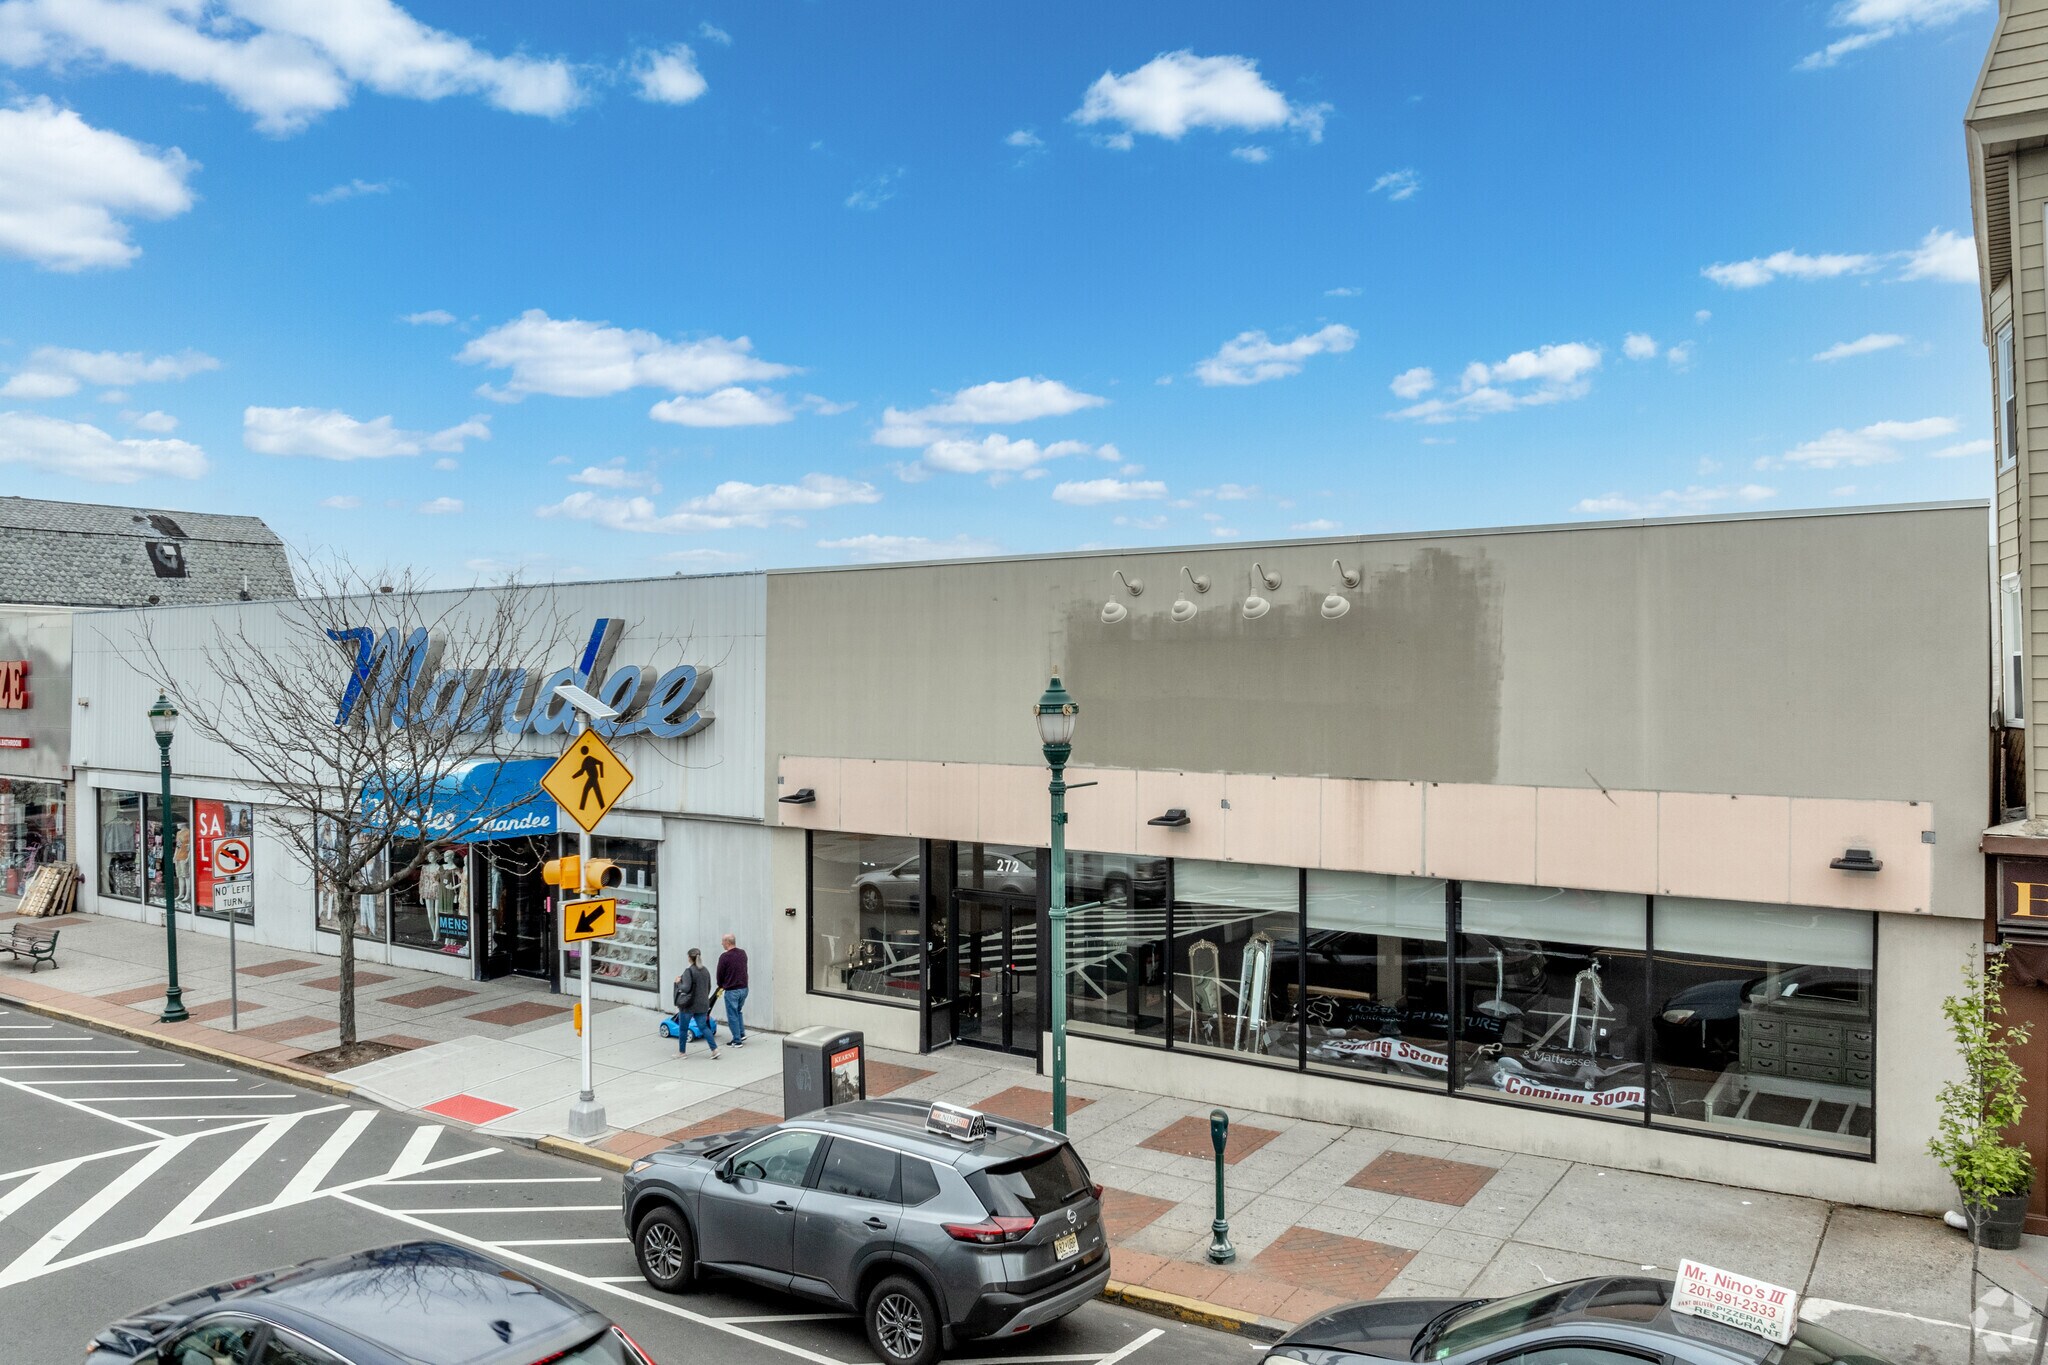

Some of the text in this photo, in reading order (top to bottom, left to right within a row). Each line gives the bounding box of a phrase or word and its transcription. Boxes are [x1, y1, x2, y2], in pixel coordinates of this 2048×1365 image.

[326, 617, 716, 738] Mandee
[470, 812, 551, 834] Mandee
[996, 859, 1019, 873] 272
[215, 884, 251, 896] NO LEFT
[223, 897, 243, 907] TURN
[439, 916, 468, 931] MENS
[1412, 1010, 1501, 1032] FURNTURE
[834, 1051, 856, 1064] KEARNY
[1534, 1051, 1598, 1068] Mattresses
[1505, 1077, 1584, 1104] Coming
[1684, 1264, 1788, 1306] Mr. Nino's III
[1688, 1282, 1776, 1319] 201-991-2333
[1694, 1306, 1781, 1338] RESTAURANT
[1716, 1305, 1764, 1325] PIZZERIA
